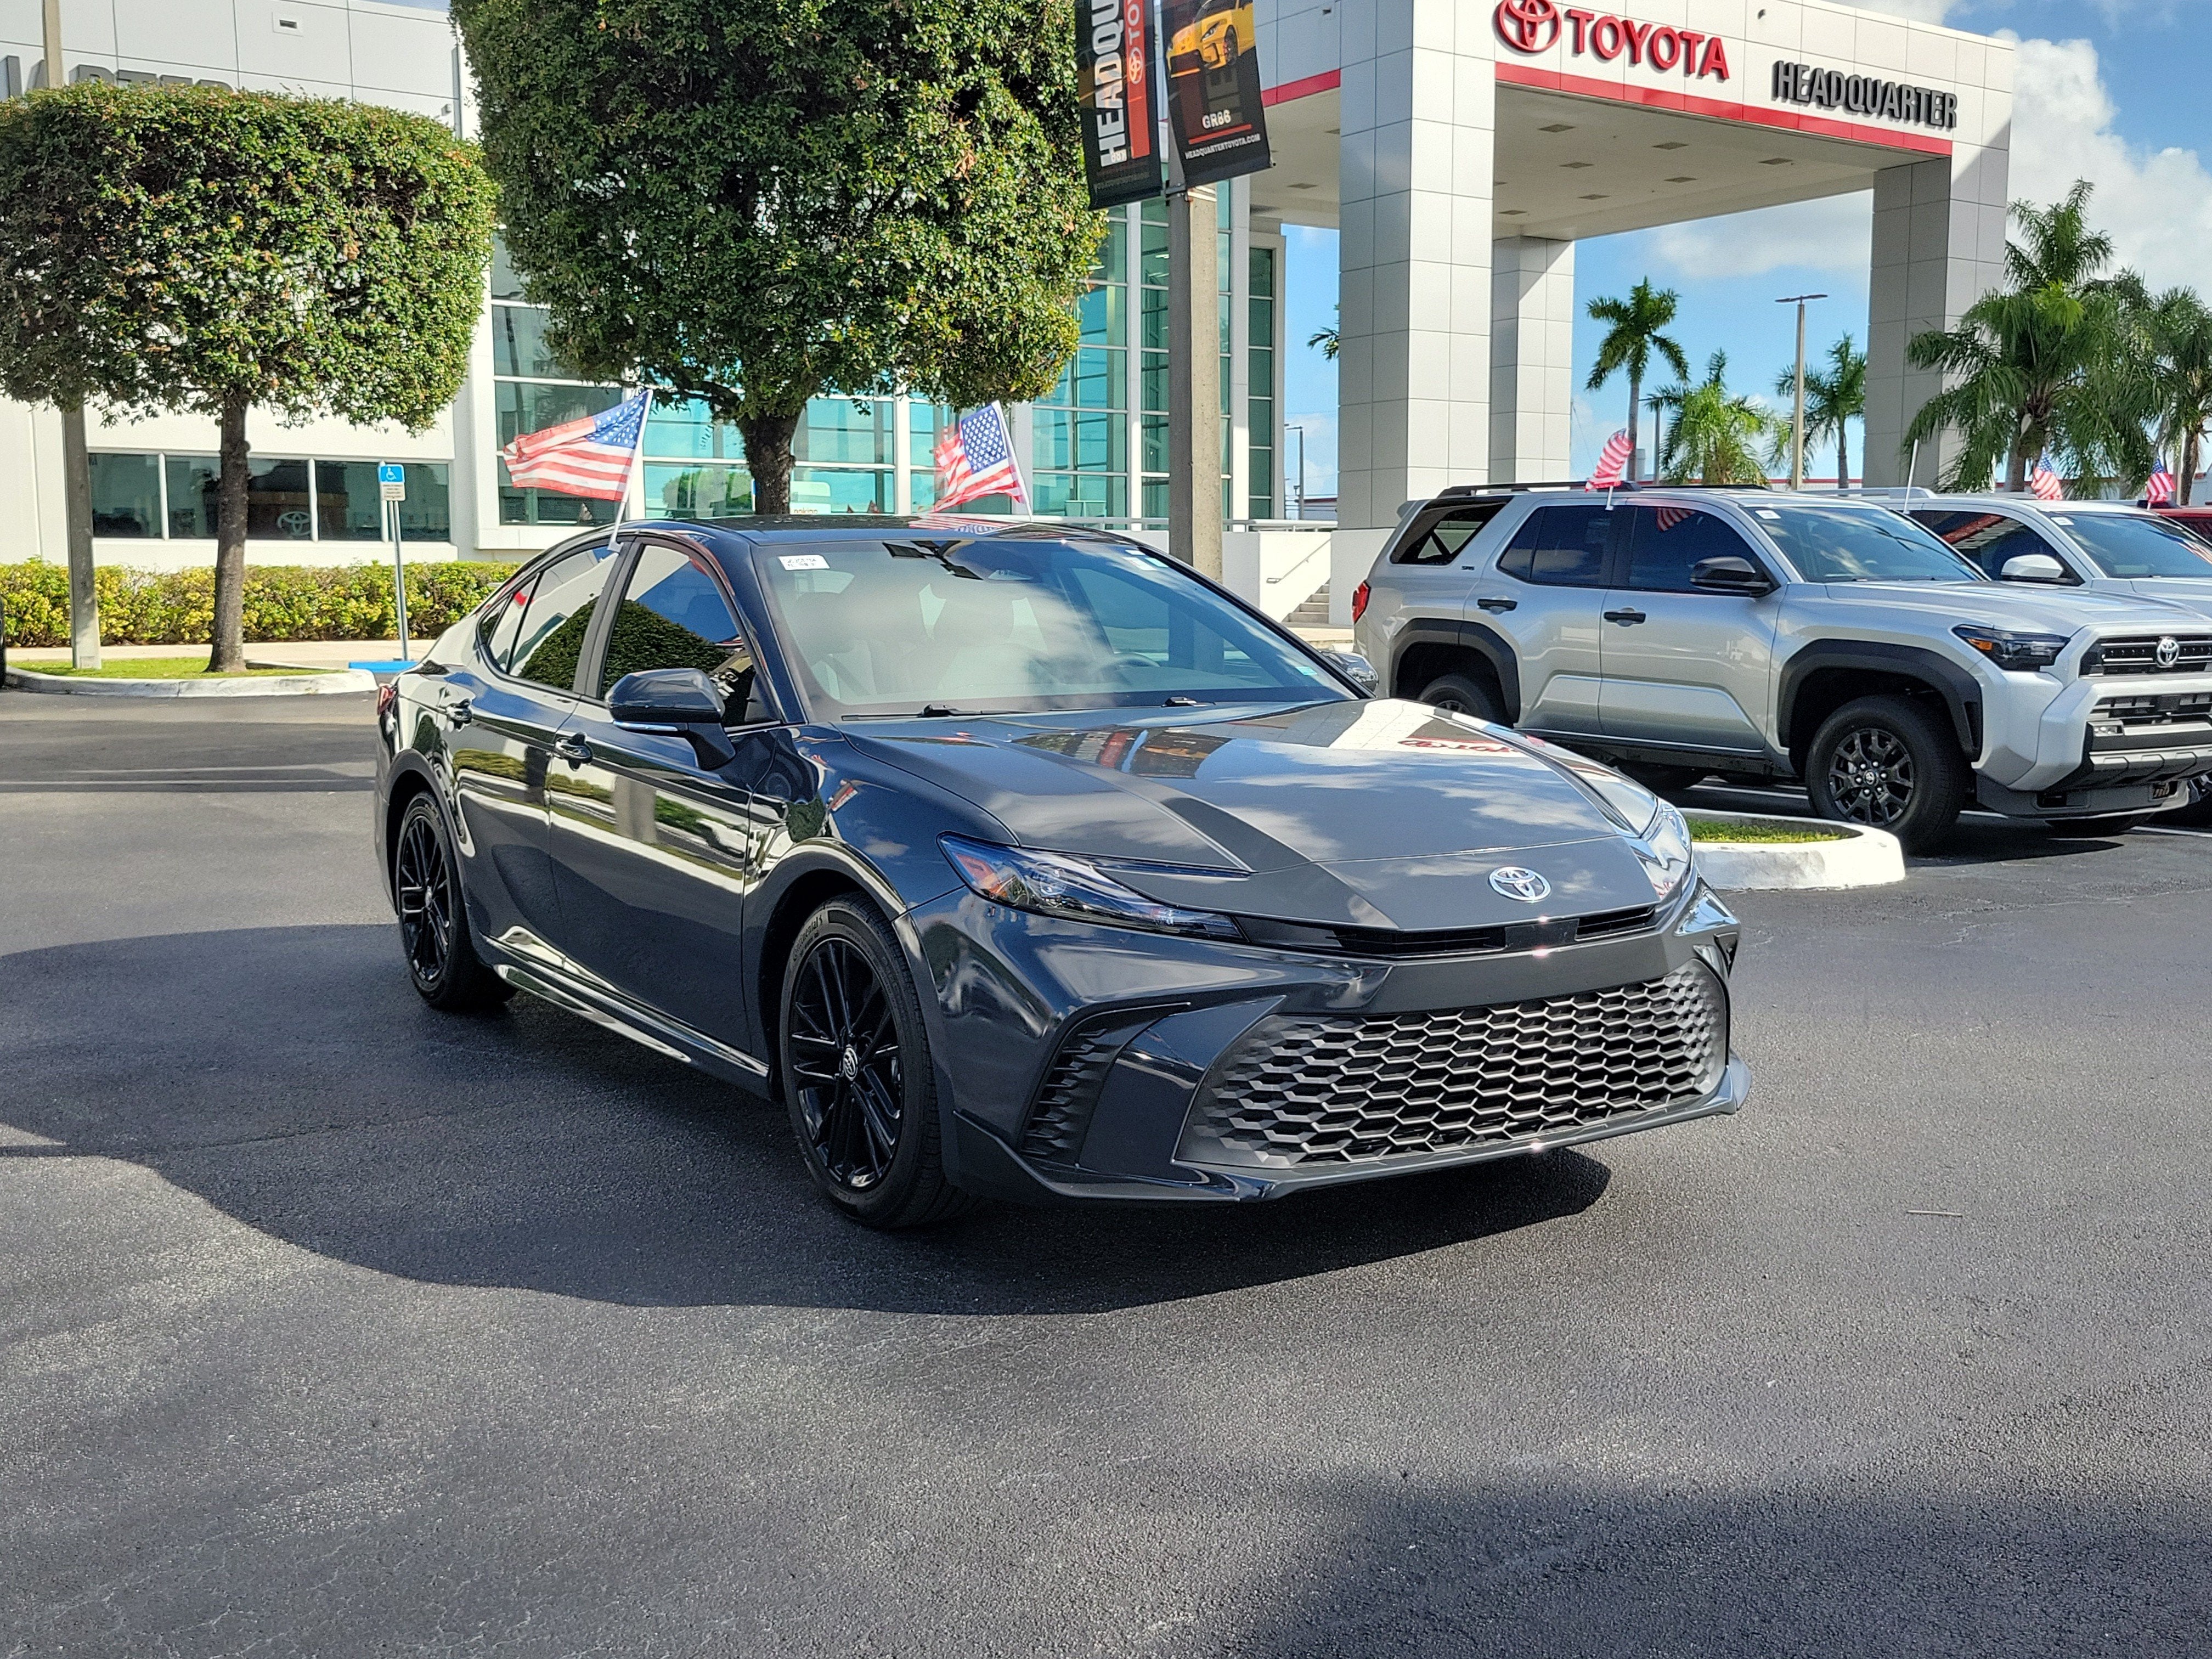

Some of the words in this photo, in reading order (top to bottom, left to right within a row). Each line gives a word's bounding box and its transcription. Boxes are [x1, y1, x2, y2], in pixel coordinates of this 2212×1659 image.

[1127, 0, 1141, 46] TO
[1565, 8, 1730, 80] TOYOTA
[1201, 109, 1232, 129] GR86
[1772, 60, 1957, 128] HEADQUARTER
